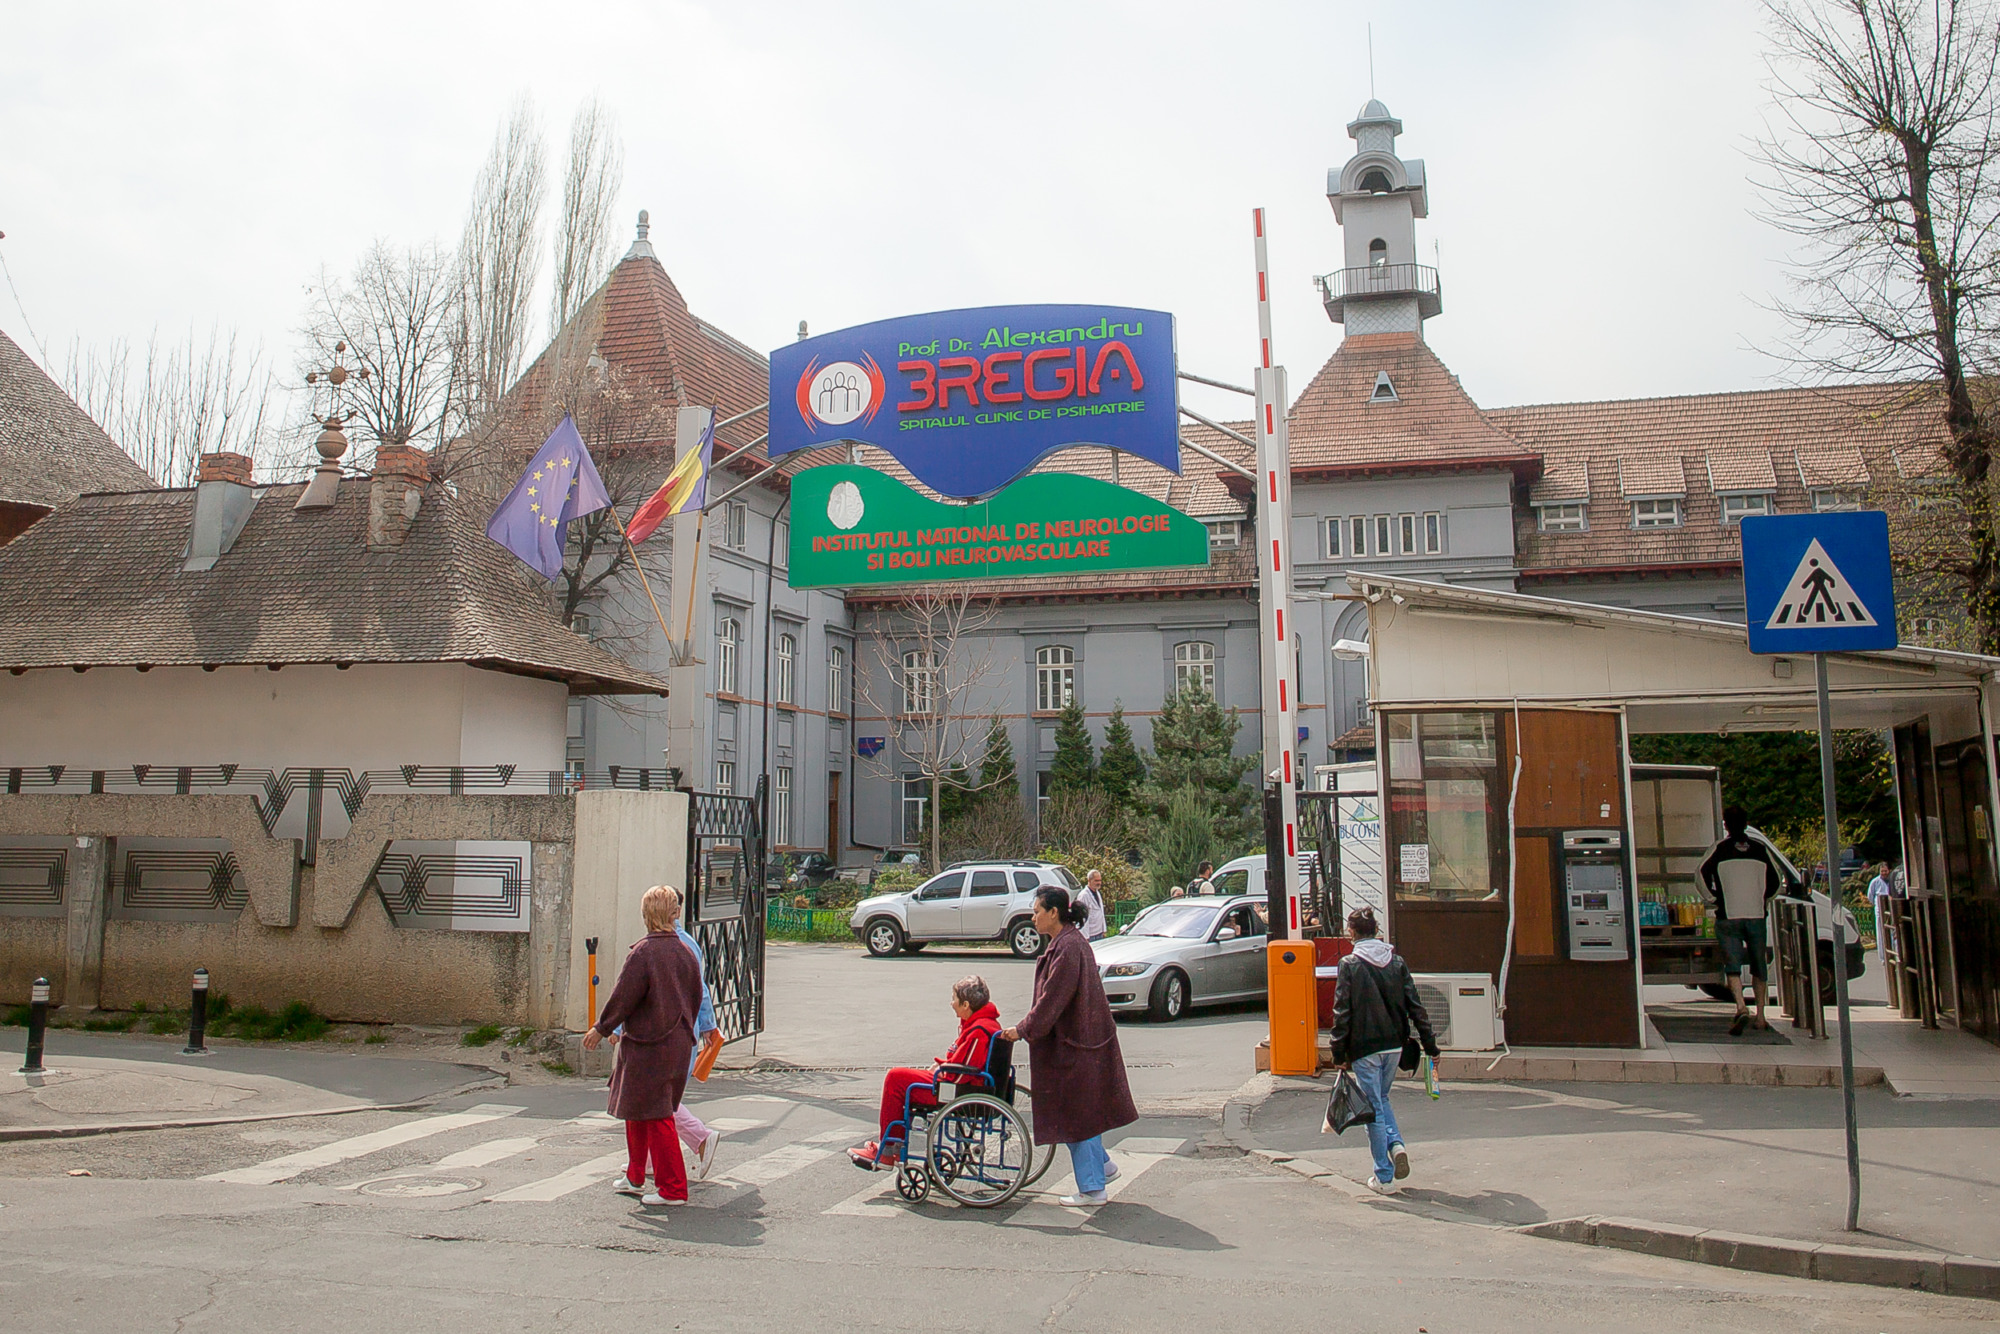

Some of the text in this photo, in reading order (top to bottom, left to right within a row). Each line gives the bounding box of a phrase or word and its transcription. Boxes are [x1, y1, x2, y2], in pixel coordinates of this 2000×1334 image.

[898, 317, 1143, 357] Prof. Dr. Alexandru
[899, 401, 1145, 431] SPITALUL CLINIC DE PSIHIATRIE
[812, 514, 1170, 553] INSTITUTUL NATIONAL DE NEUROLOGIE
[867, 540, 1110, 571] SI BOLI NEUROVASCULARE
